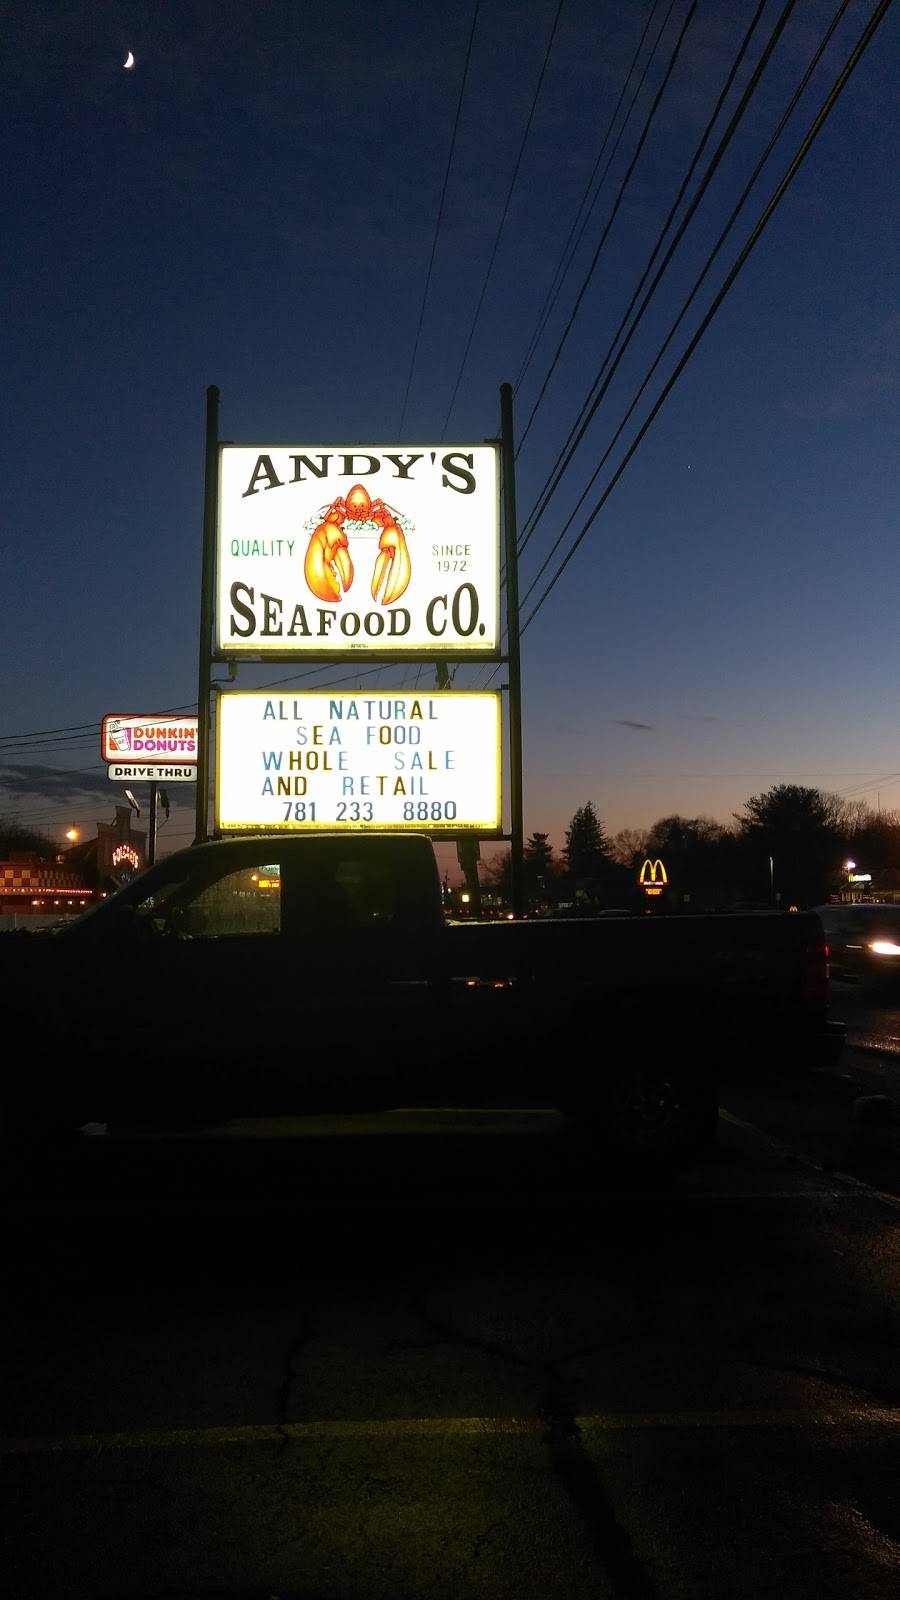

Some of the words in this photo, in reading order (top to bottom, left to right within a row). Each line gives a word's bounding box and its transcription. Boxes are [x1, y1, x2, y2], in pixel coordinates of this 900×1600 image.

[241, 452, 477, 498] ANDY'S
[230, 539, 296, 557] QUALITY
[432, 544, 471, 556] SINCE
[436, 560, 467, 572] 1972
[229, 581, 411, 637] SEAFOOD
[425, 582, 486, 636] CO.
[262, 700, 303, 720] ALL
[329, 700, 438, 720] NATURAL
[133, 740, 195, 751] DONUTS
[296, 726, 342, 746] SEA
[366, 725, 421, 745] FOOD
[262, 751, 349, 771] WHOLE
[394, 750, 455, 770] SALE
[114, 767, 154, 777] DRIVE
[157, 768, 192, 777] THRU
[261, 776, 307, 796] AND
[342, 775, 429, 796] RETAIL
[283, 801, 317, 822] 781
[335, 801, 374, 822] 233
[403, 800, 457, 821] 8880
